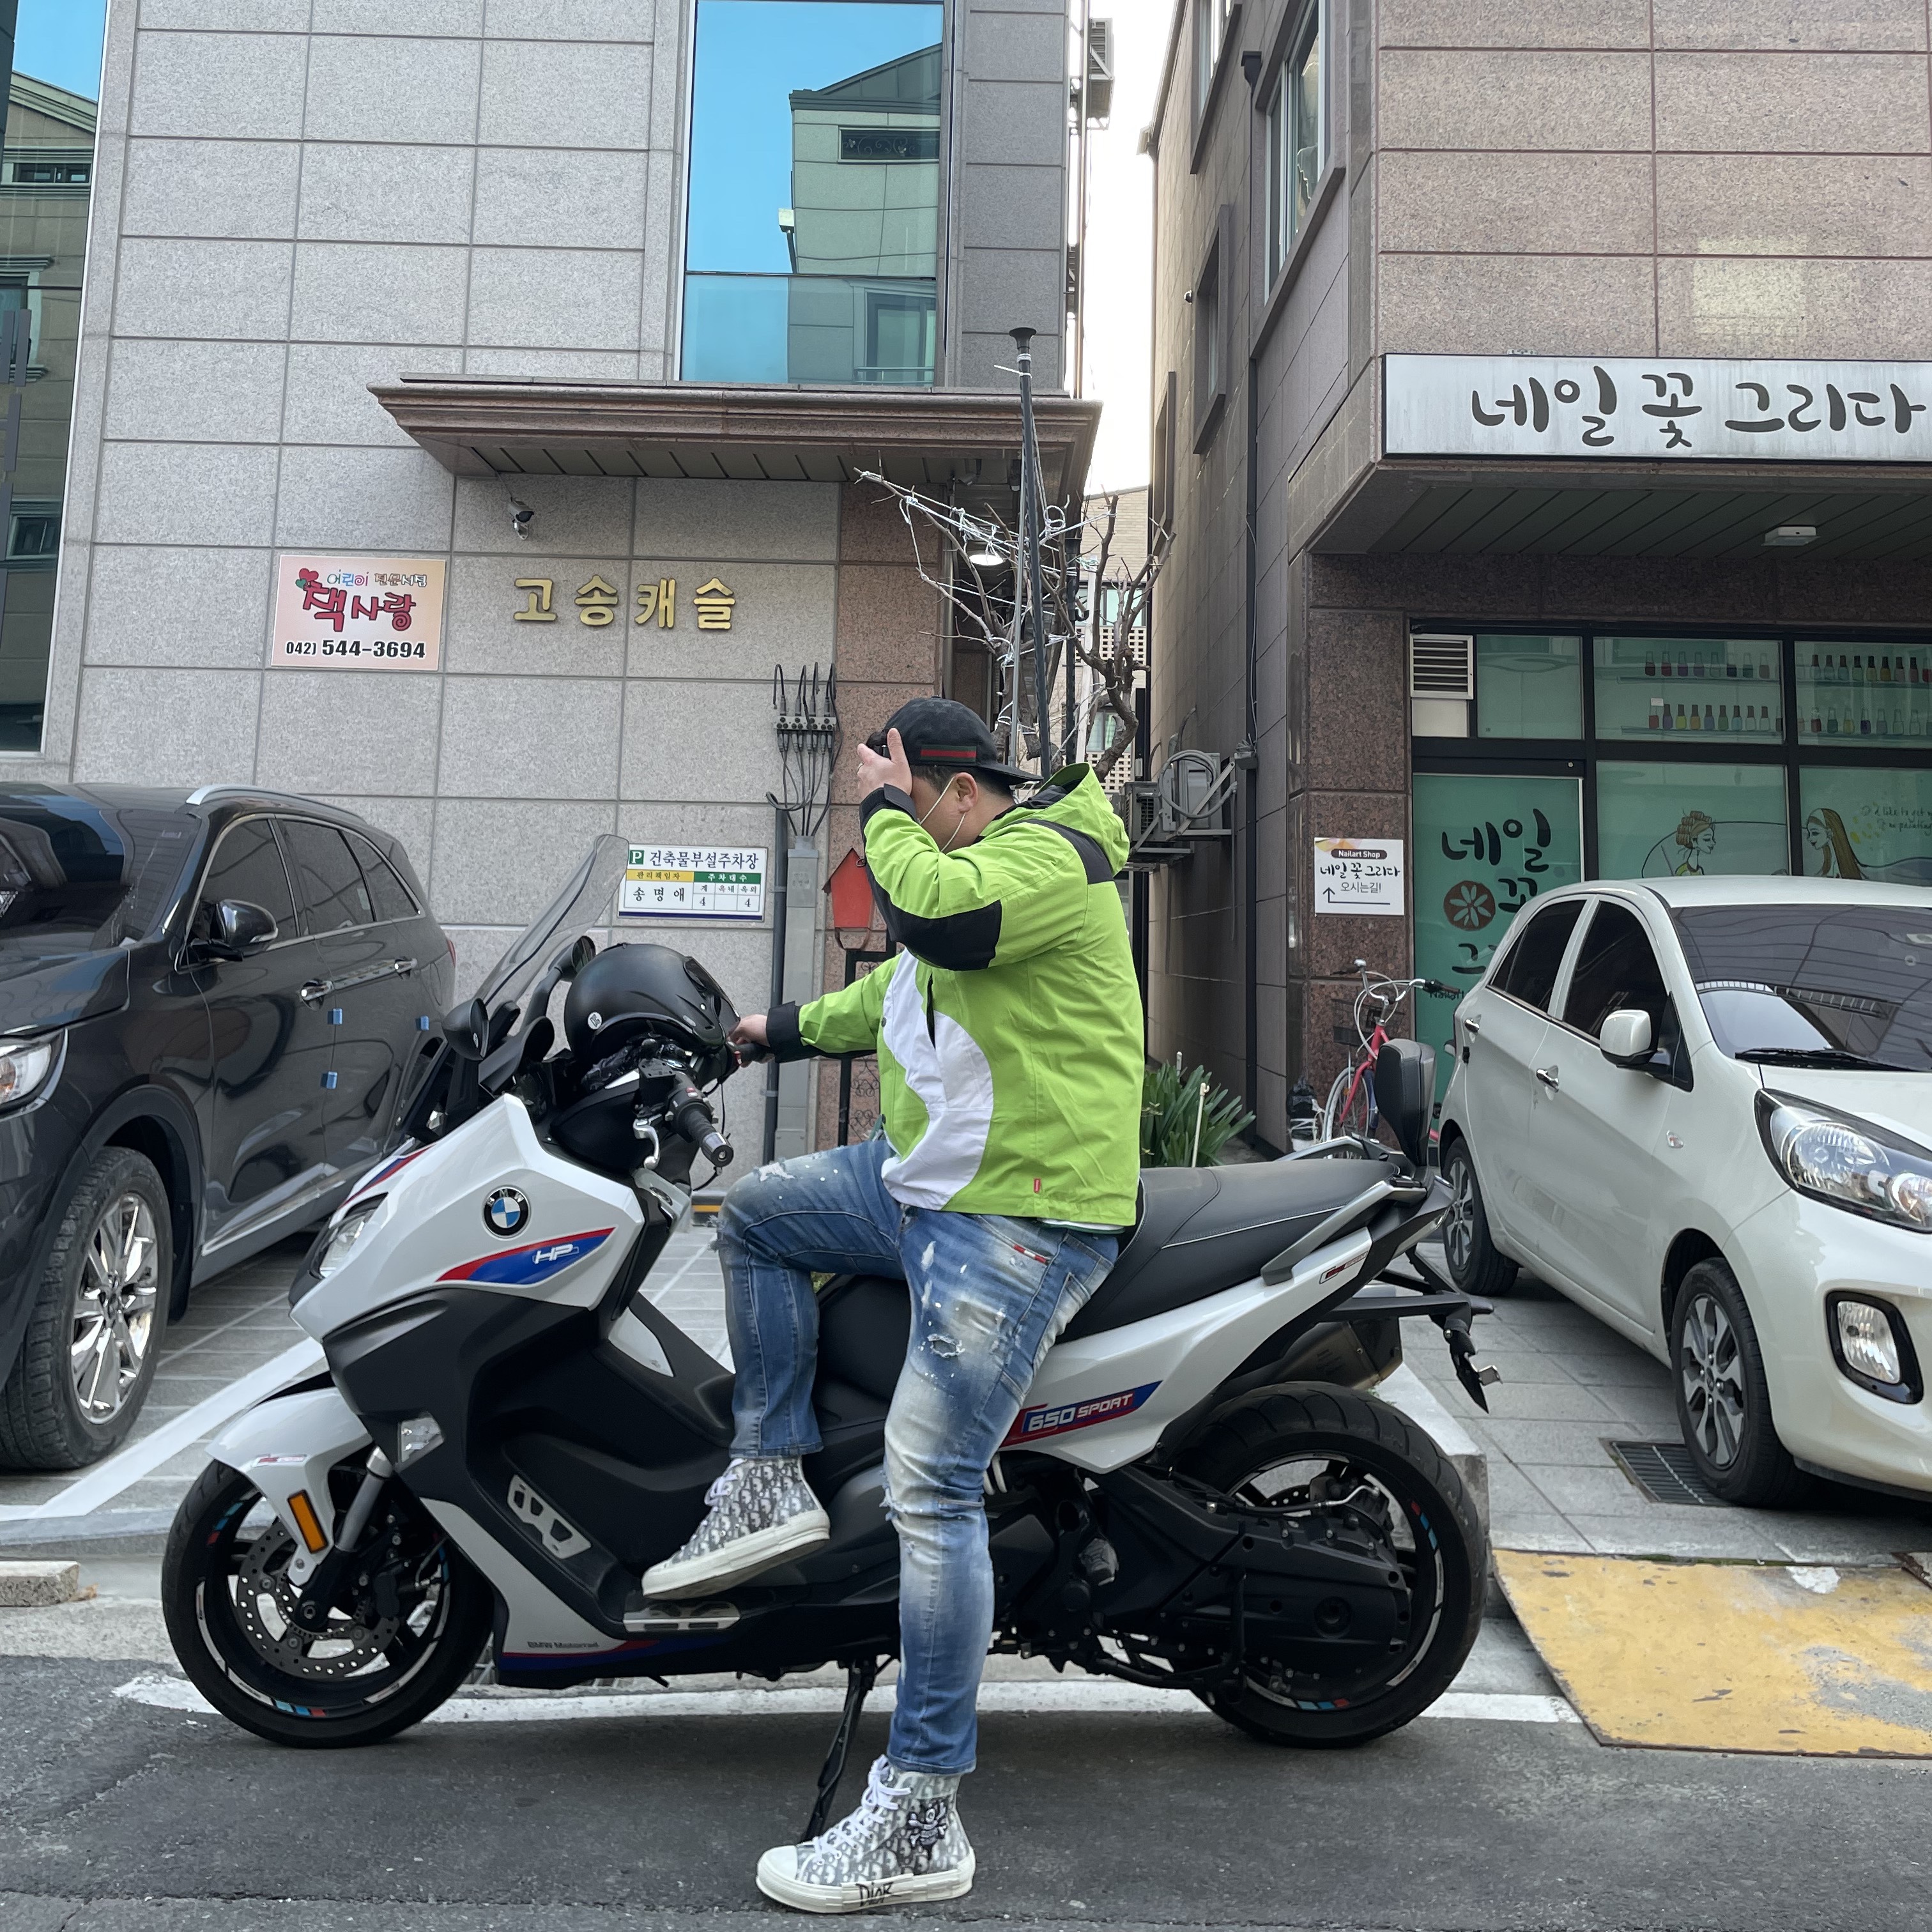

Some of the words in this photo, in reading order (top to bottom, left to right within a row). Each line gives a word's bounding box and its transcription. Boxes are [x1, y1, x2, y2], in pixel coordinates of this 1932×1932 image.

[1472, 366, 1617, 447] 네일
[1641, 372, 1702, 448] 꽃
[1724, 382, 1926, 433] 그리다
[327, 569, 369, 586] 어린이
[374, 572, 427, 588] 전문서점
[514, 574, 736, 631] 고송캐슬
[286, 641, 317, 656] 042)
[322, 640, 425, 659] 544-3694
[1441, 808, 1551, 873] 네일
[649, 850, 759, 870] 건축물부설주차장
[1363, 850, 1381, 859] Shop
[636, 871, 680, 880] 관리책임자
[707, 873, 747, 882] 주차대수
[1320, 862, 1347, 879] 네일
[1350, 862, 1363, 879] 꽃
[1365, 865, 1401, 877] 그리다
[1340, 882, 1381, 894] 오시는길!
[699, 896, 706, 907] 4
[744, 898, 751, 908] 4
[487, 1189, 525, 1207] BMW
[534, 1244, 574, 1264] HP
[1028, 1407, 1077, 1432] 650
[1077, 1393, 1133, 1418] SPORT
